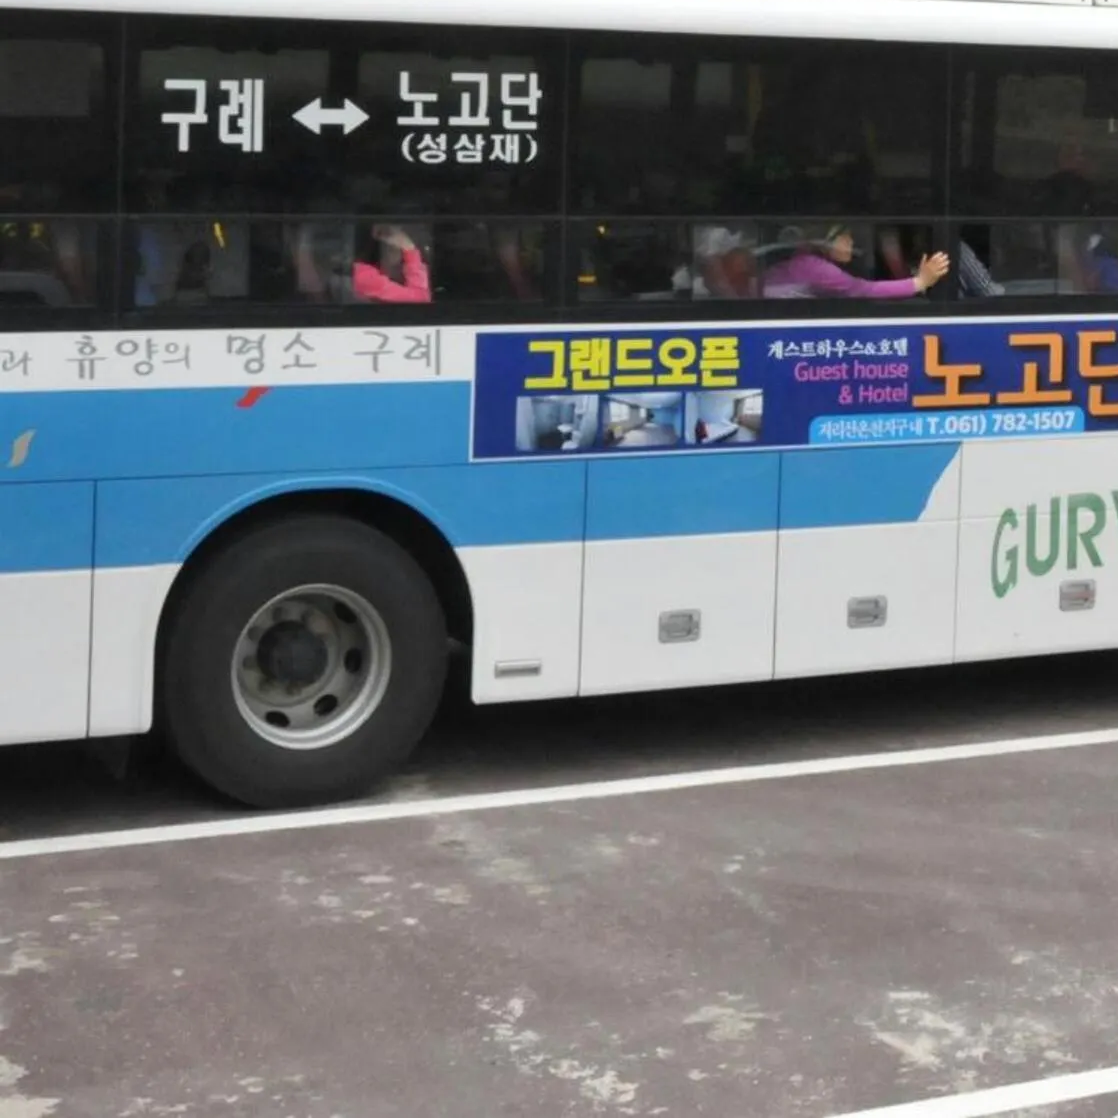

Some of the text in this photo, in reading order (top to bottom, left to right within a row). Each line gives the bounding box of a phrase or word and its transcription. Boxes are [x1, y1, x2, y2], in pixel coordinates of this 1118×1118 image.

[161, 78, 265, 152] 구례
[397, 72, 543, 131] 노고단
[401, 132, 539, 164] (성삼재)
[66, 335, 191, 380] 휴양의
[226, 332, 318, 374] 명소
[354, 328, 442, 376] 구례
[524, 336, 740, 391] 그랜드오픈
[794, 359, 909, 382] Guest house
[839, 382, 908, 405] & Hotel
[991, 410, 1076, 433] 782-1507
